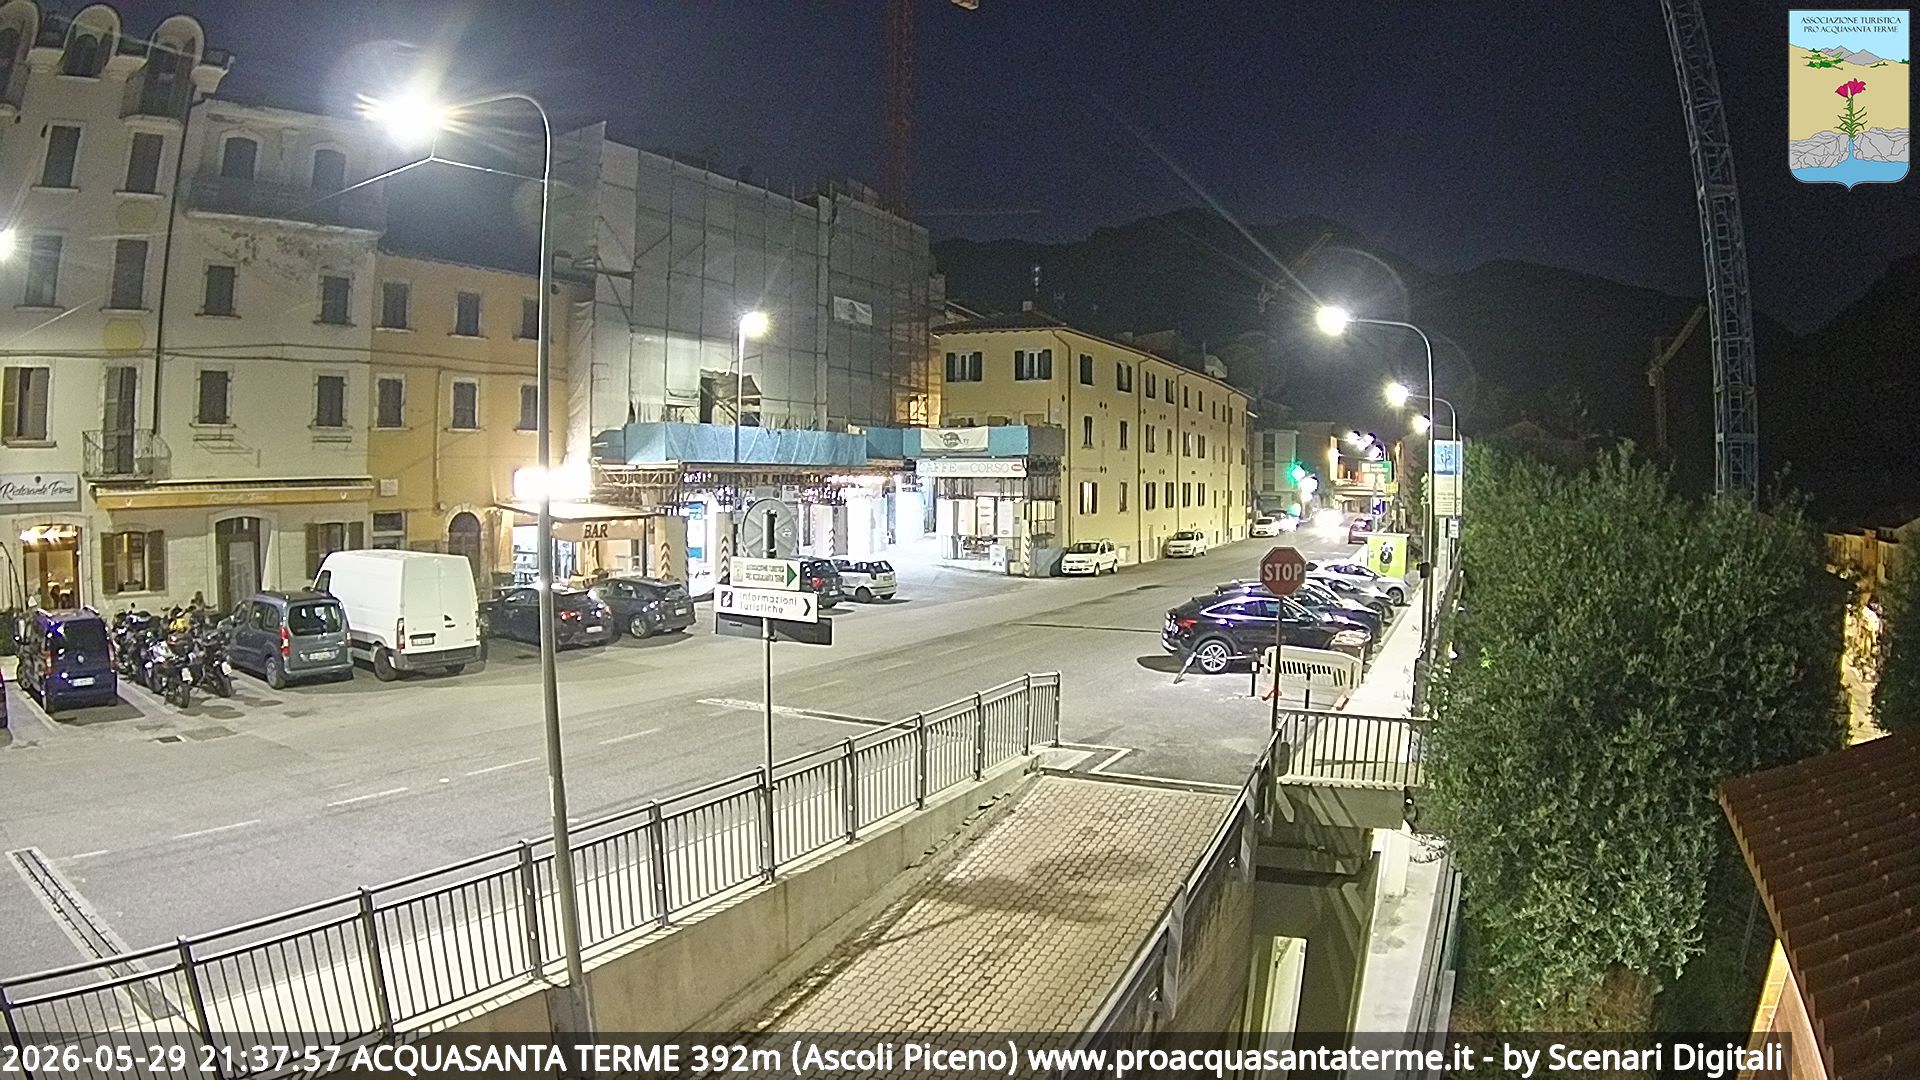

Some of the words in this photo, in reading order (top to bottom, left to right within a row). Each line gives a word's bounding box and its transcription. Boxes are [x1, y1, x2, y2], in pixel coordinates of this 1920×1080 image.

[970, 463, 1010, 473] CORSO
[583, 523, 608, 539] BAR
[1263, 563, 1303, 581] STOP
